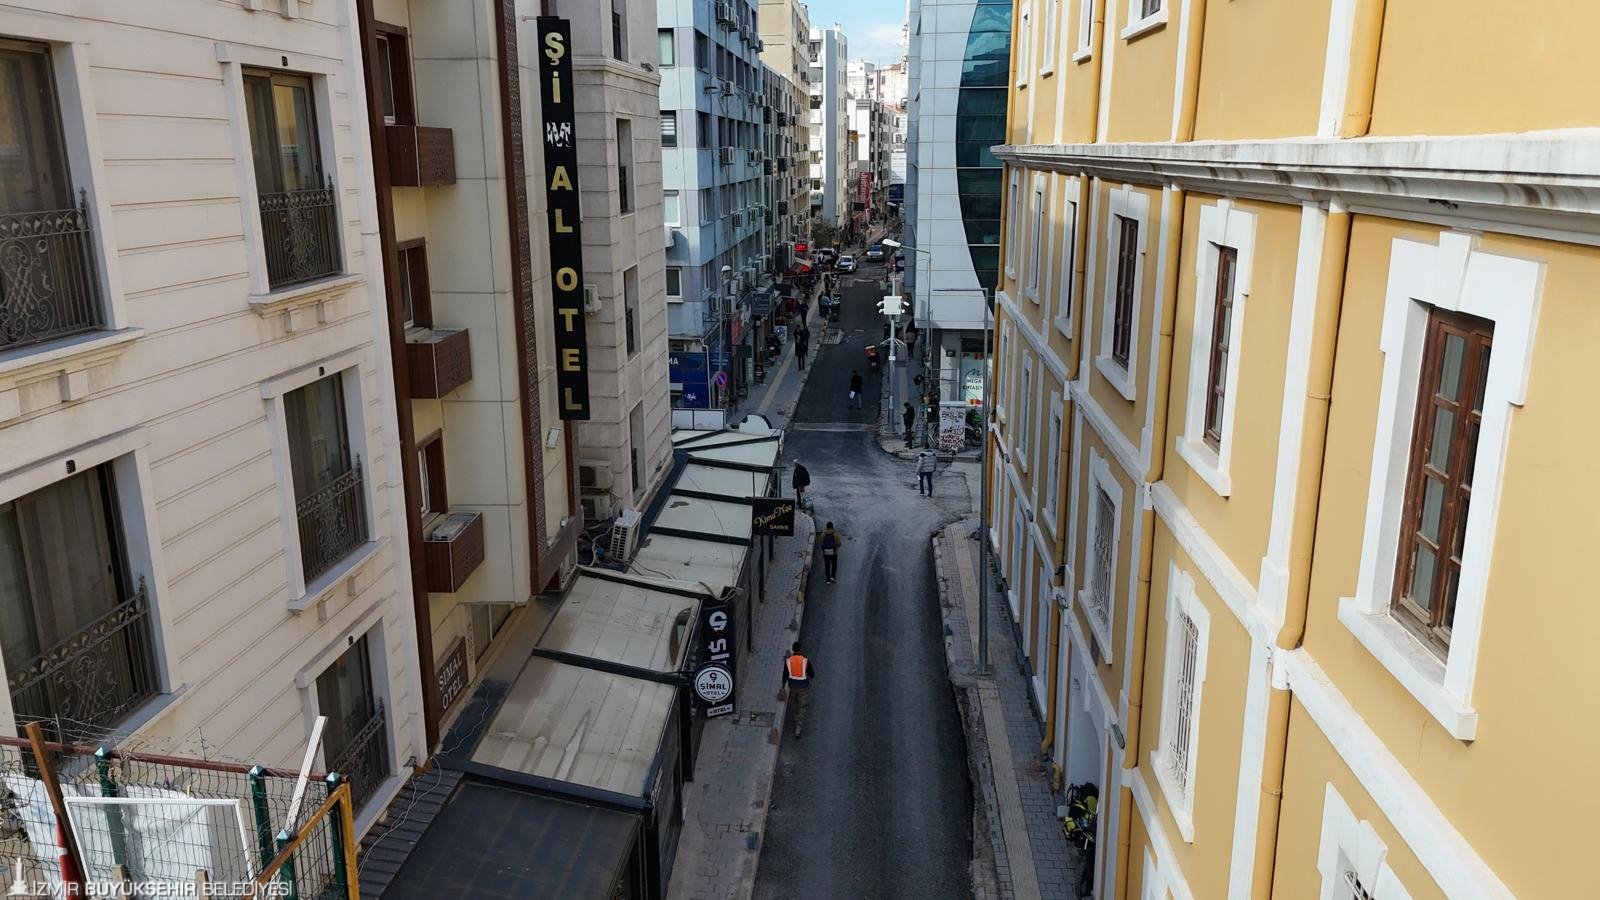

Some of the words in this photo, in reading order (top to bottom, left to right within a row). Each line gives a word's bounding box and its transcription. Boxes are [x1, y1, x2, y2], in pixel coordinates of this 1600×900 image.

[544, 31, 574, 233] ŞİMAL
[556, 267, 582, 411] OTEL
[442, 675, 463, 710] OTEL
